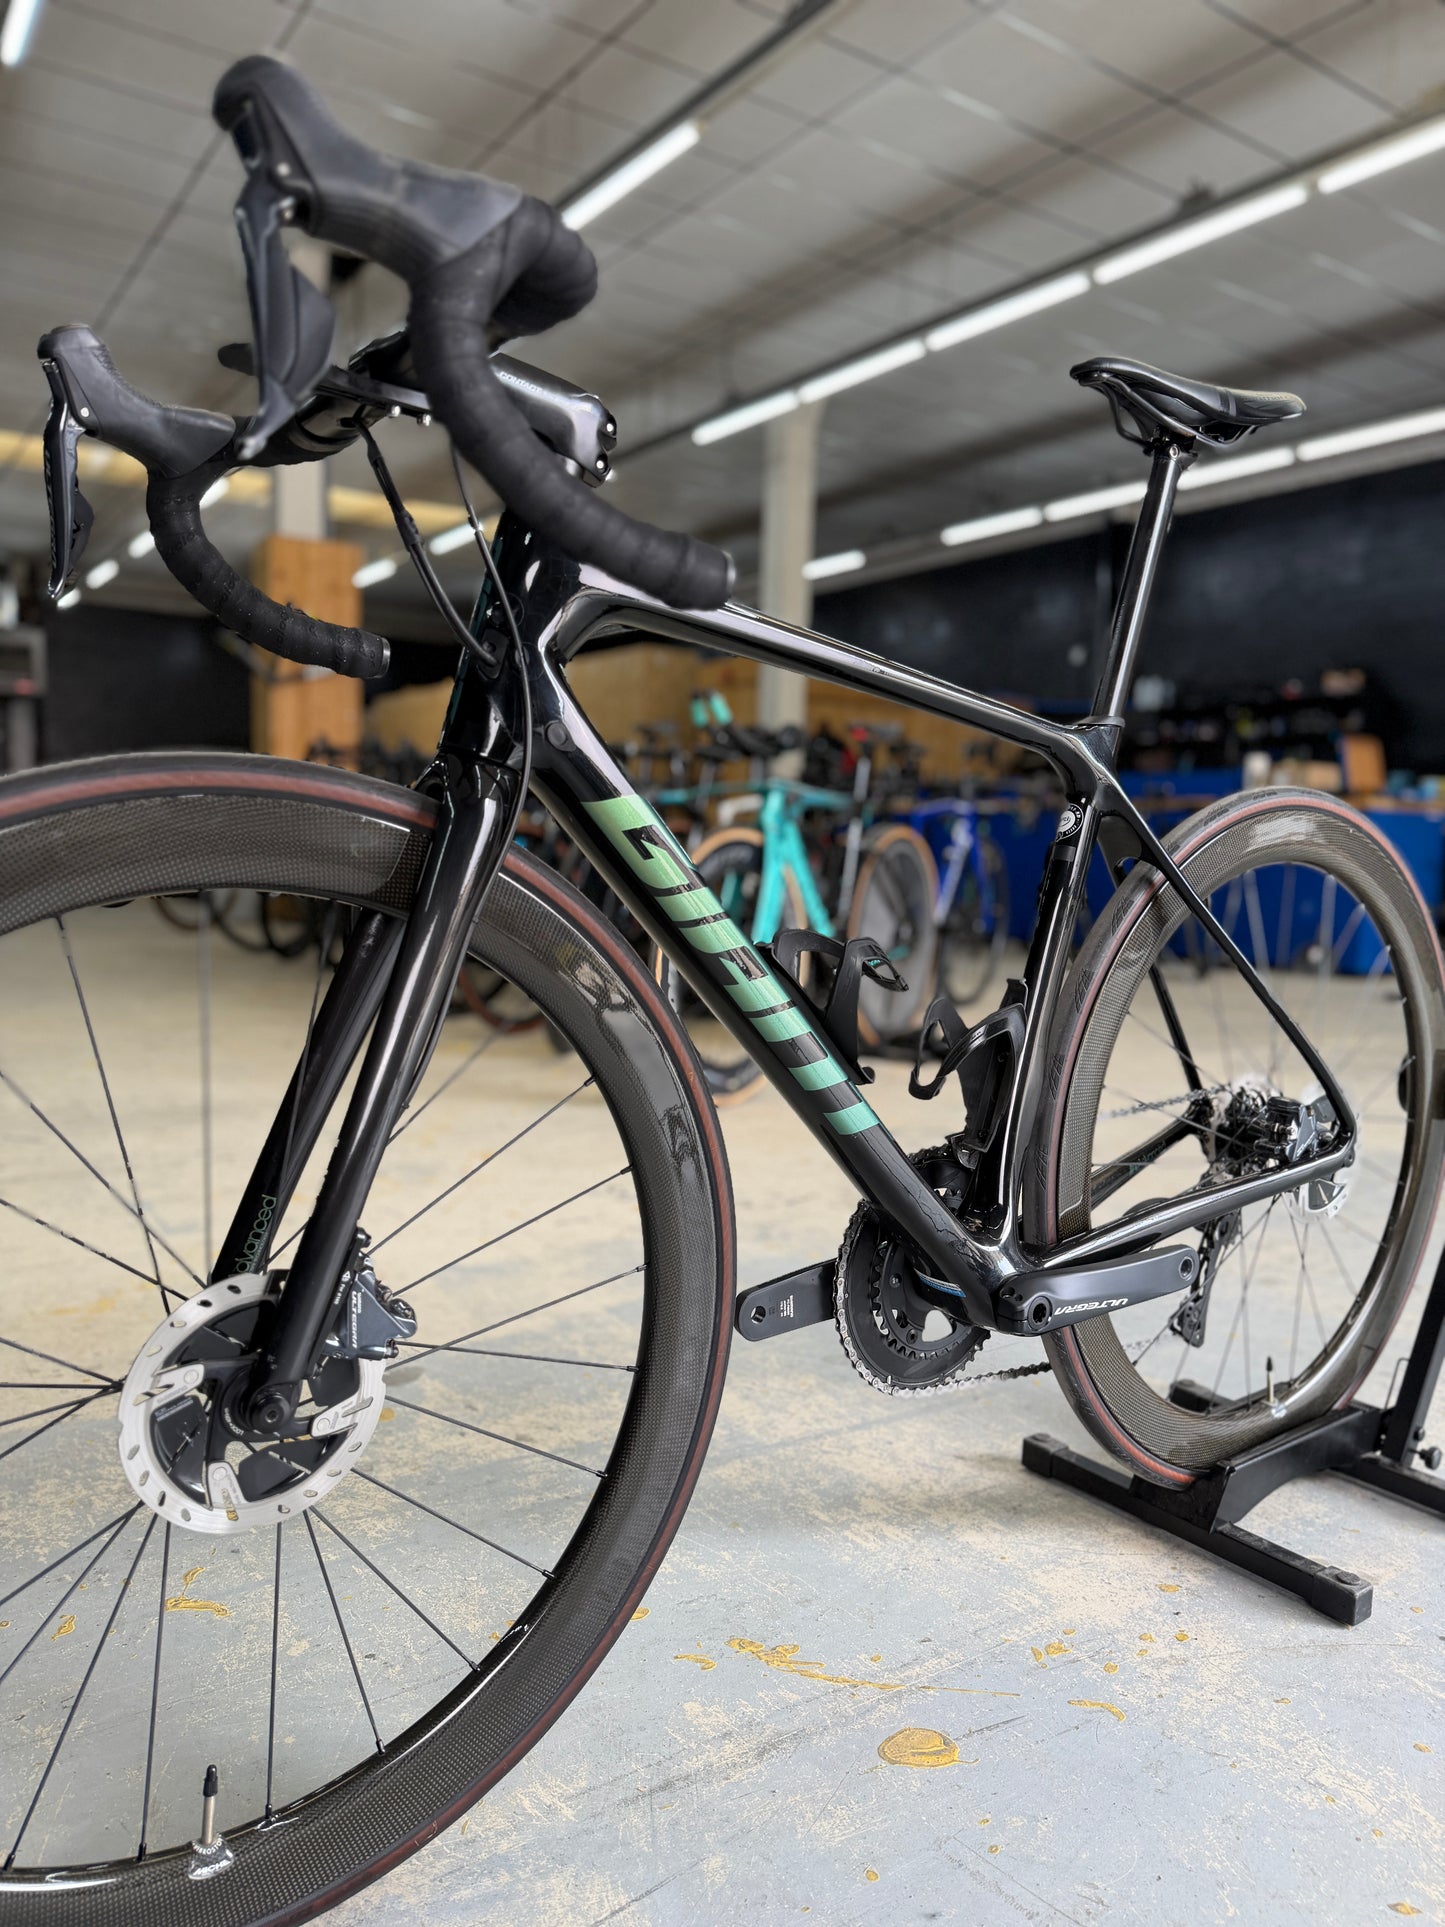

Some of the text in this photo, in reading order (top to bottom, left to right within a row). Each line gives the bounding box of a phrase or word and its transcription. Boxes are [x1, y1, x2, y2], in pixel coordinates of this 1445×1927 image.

[582, 794, 880, 1136] GIANT
[235, 1193, 277, 1273] advanced
[1054, 1298, 1128, 1316] ULTEGRA
